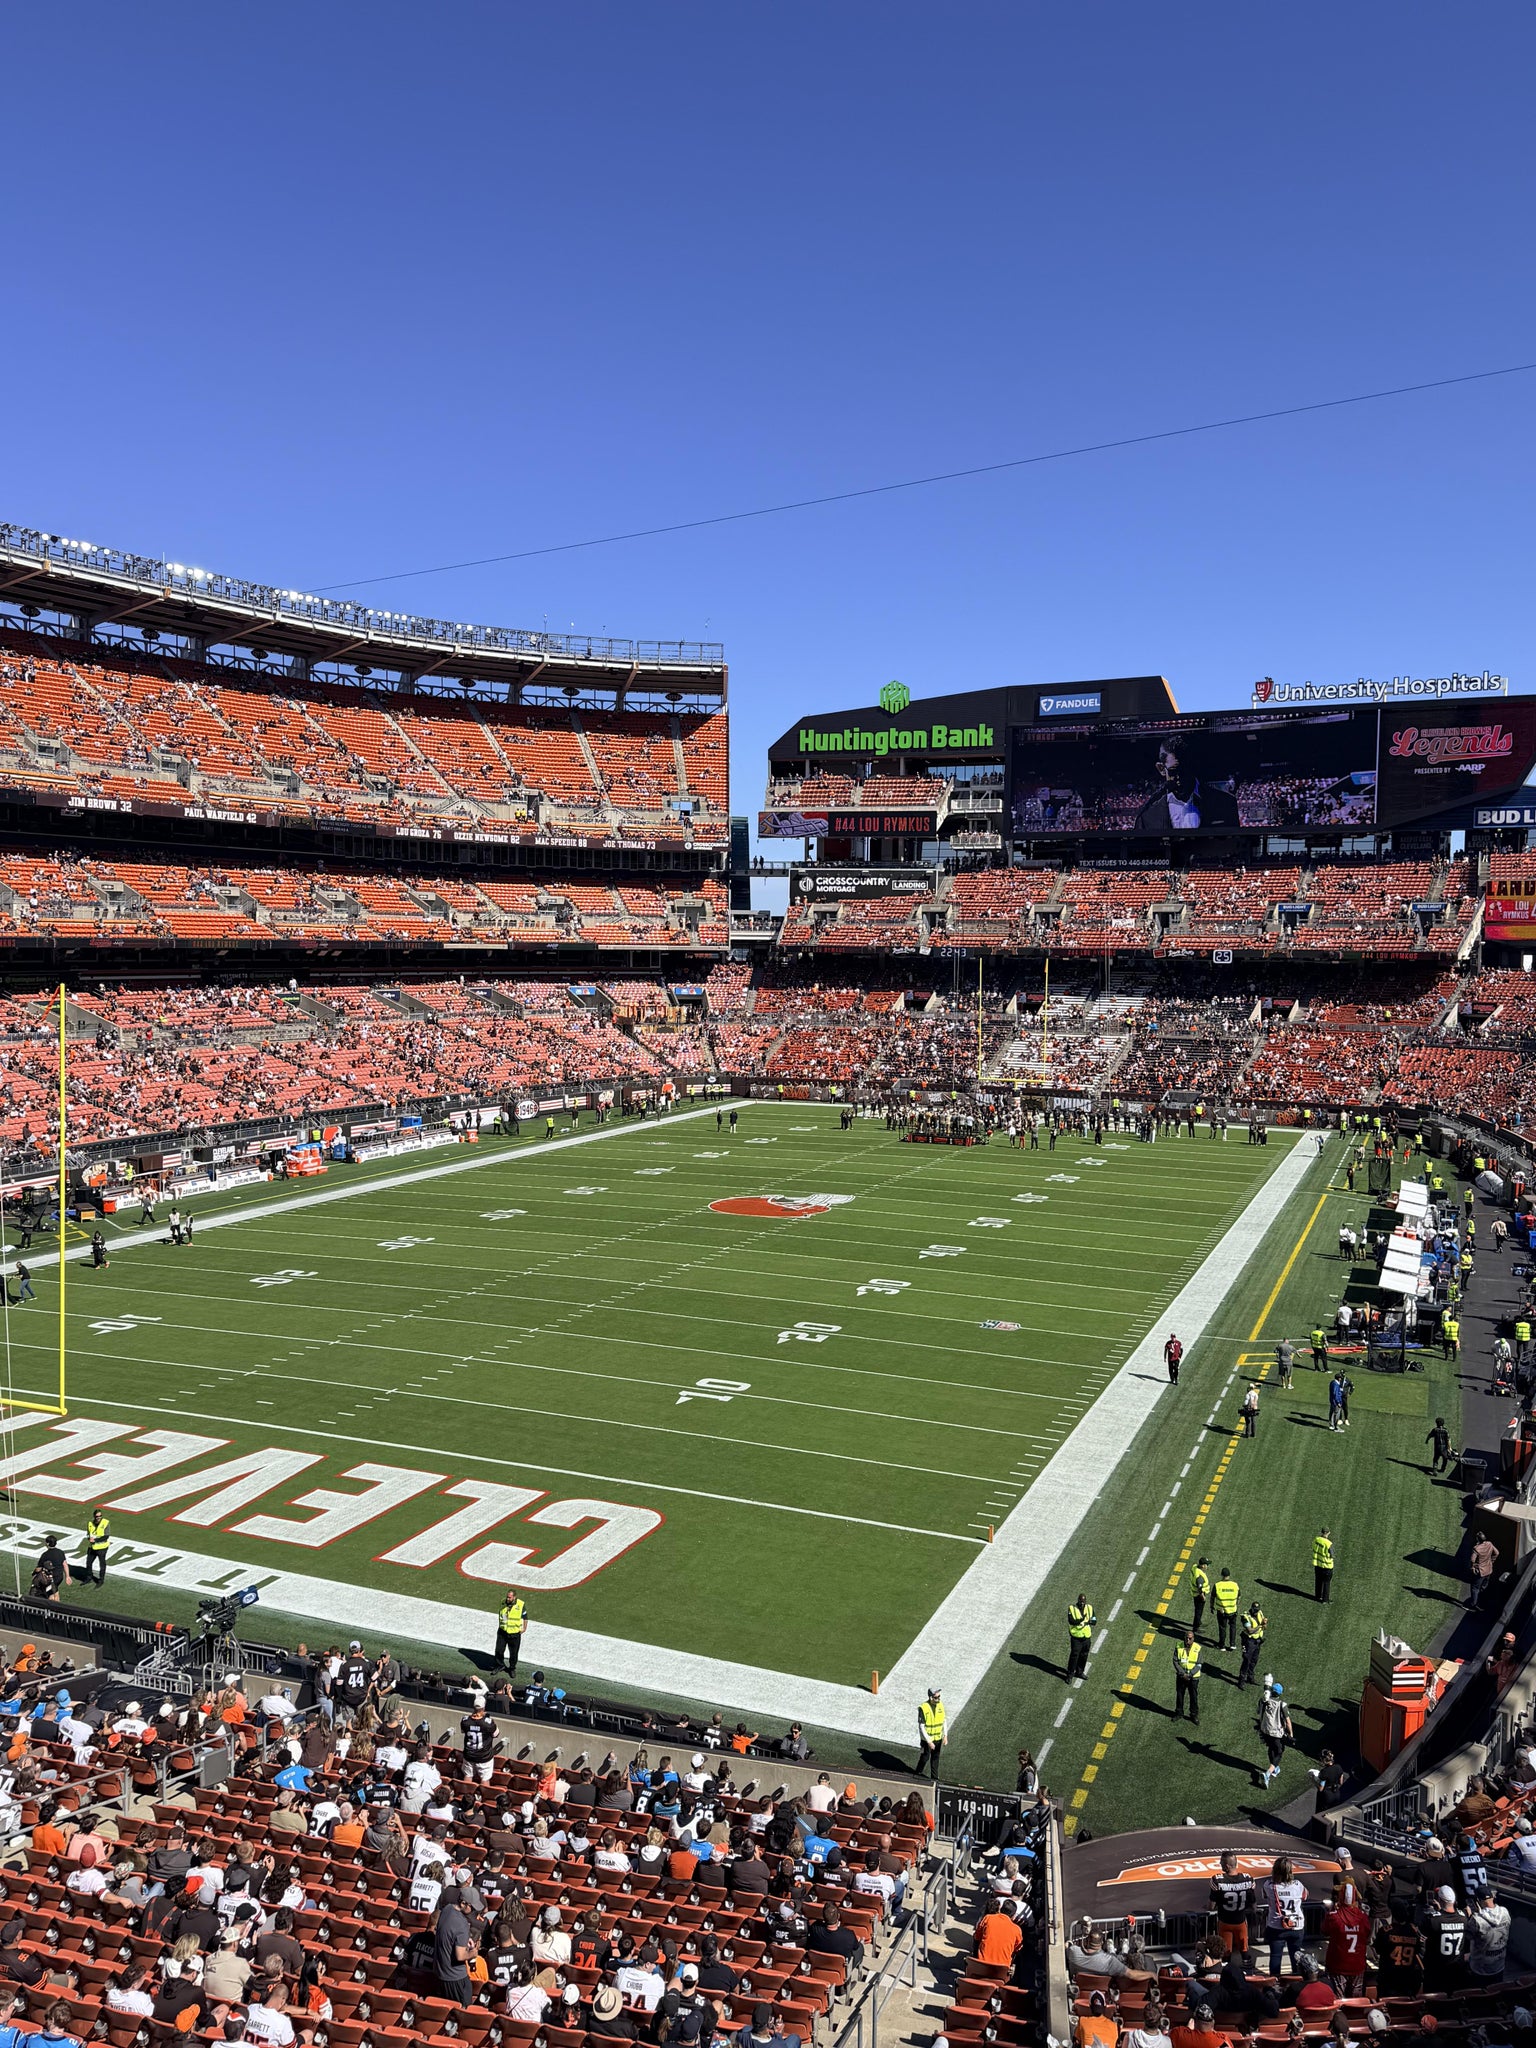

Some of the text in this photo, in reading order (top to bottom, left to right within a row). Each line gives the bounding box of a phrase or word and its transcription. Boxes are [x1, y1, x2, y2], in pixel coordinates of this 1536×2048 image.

[1275, 671, 1501, 702] University Hospitals
[1055, 698, 1101, 709] FANDUEL
[1420, 726, 1492, 738] CLEVELAND BROWNS
[799, 723, 994, 756] Huntington Bank
[1389, 724, 1513, 764] Legends
[1414, 767, 1443, 775] PRESENTED
[1455, 763, 1486, 772] AARP
[68, 797, 132, 812] JIM BROWN 32
[184, 808, 257, 823] PAUL WARFIELD 42
[1477, 810, 1521, 825] BUD
[835, 816, 930, 832] #44 LOU RYMKUS
[396, 827, 442, 839] LOU GROZA 76
[454, 832, 520, 844] OZZIE NEWSOME 82
[535, 836, 550, 846] MAC
[551, 837, 577, 847] SPEEDIE
[603, 840, 656, 850] JOE THOMAS 73
[1079, 859, 1095, 867] TEXT
[1095, 859, 1117, 867] ISSUES
[1118, 859, 1128, 867] TO
[816, 876, 890, 887] CROSSCOUNTRY
[894, 881, 926, 889] LANDING
[816, 885, 856, 893] MORTGAGE
[1515, 901, 1529, 910] LOU
[1503, 911, 1529, 919] RYMKUS
[1215, 951, 1230, 962] 25
[519, 1103, 534, 1116] 1946
[1053, 1097, 1092, 1113] POUND
[856, 1278, 912, 1295] 30
[777, 1321, 842, 1343] 20
[677, 1377, 752, 1402] 10
[348, 1672, 364, 1688] 44
[636, 1796, 648, 1813] 8
[308, 1817, 331, 1839] 24
[598, 1858, 617, 1866] KOSAR
[413, 1882, 434, 1892] GARRETT
[1462, 1867, 1488, 1895] 59
[410, 1896, 432, 1912] 95
[1222, 1890, 1247, 1912] 31
[775, 1929, 790, 1940] SIPE
[415, 1942, 434, 1955] FLACCO
[579, 1940, 596, 1951] CHUBB
[1346, 1934, 1358, 1953] 7
[1440, 1932, 1464, 1956] 67
[574, 1951, 597, 1969] 24
[1390, 1945, 1415, 1967] 49
[626, 1980, 644, 1991] CHUBB
